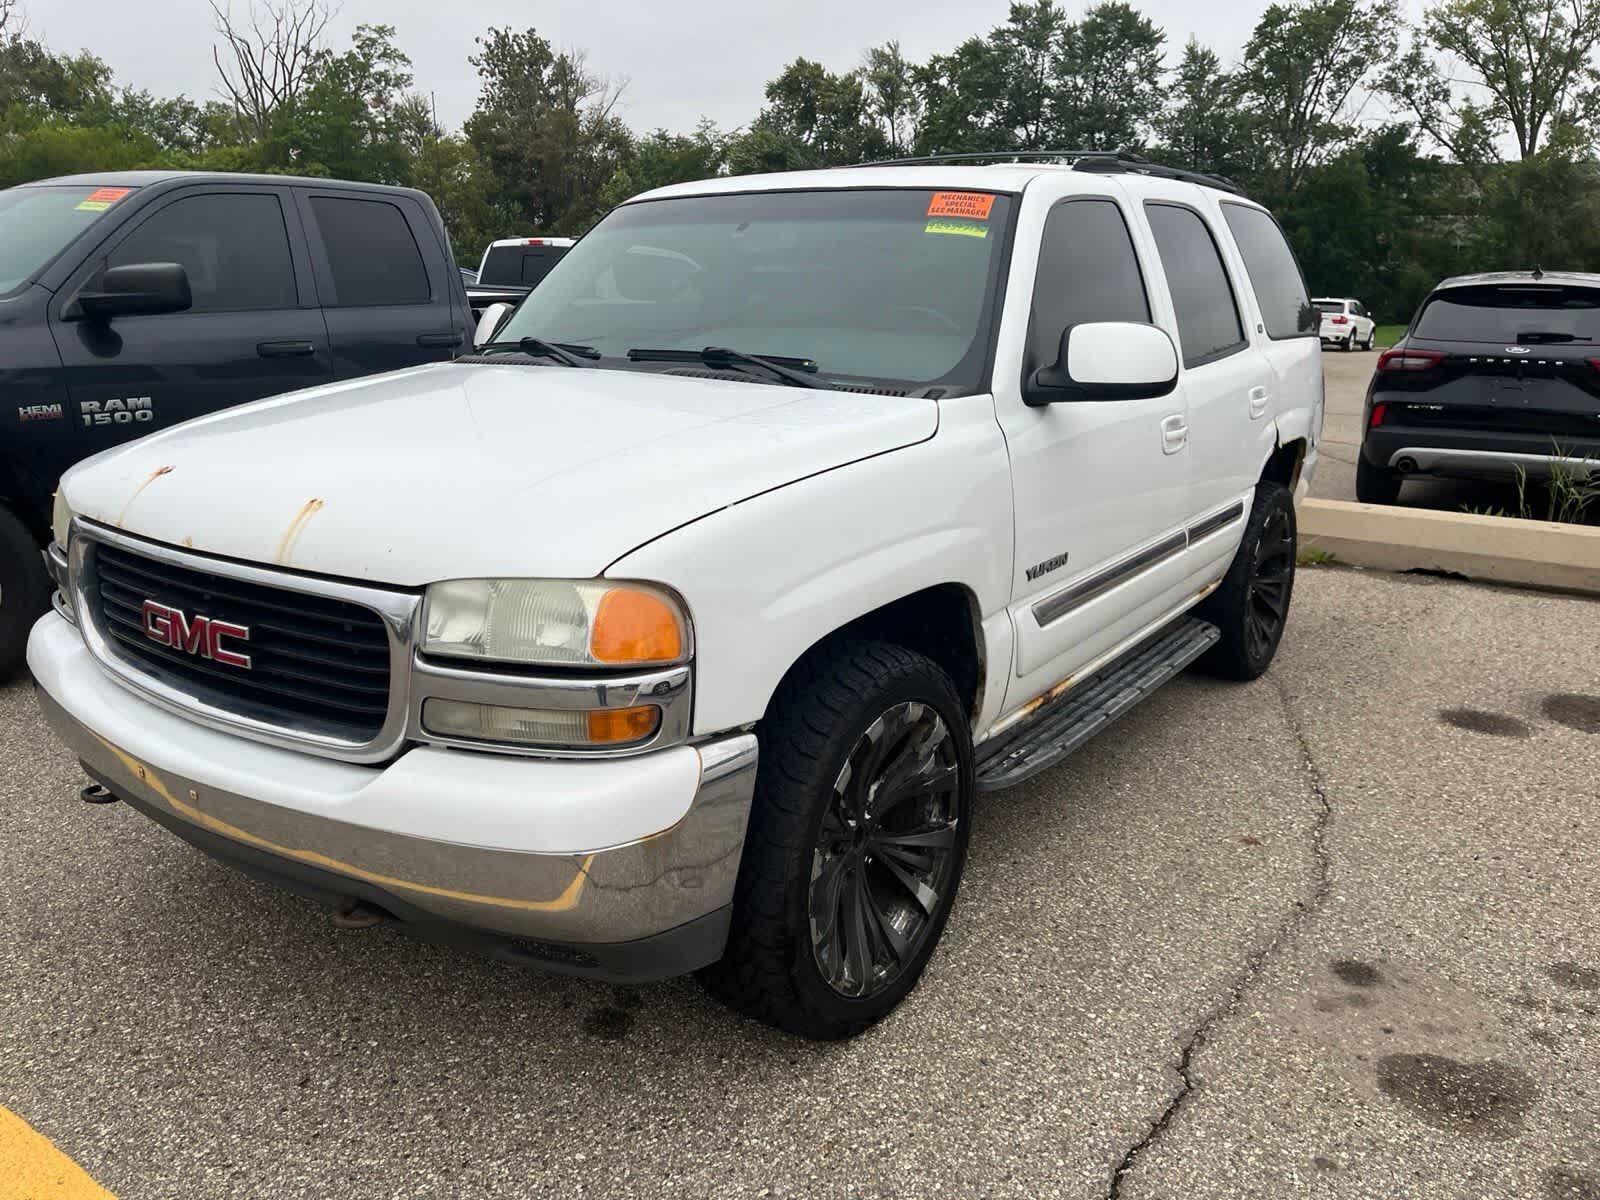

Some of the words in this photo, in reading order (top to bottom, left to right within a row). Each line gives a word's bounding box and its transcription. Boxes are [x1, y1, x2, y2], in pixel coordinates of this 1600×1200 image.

[946, 207, 986, 217] MANAGER
[18, 403, 62, 416] HEMI
[80, 397, 152, 412] RAM
[82, 409, 153, 426] 1500
[142, 599, 252, 670] GMC
